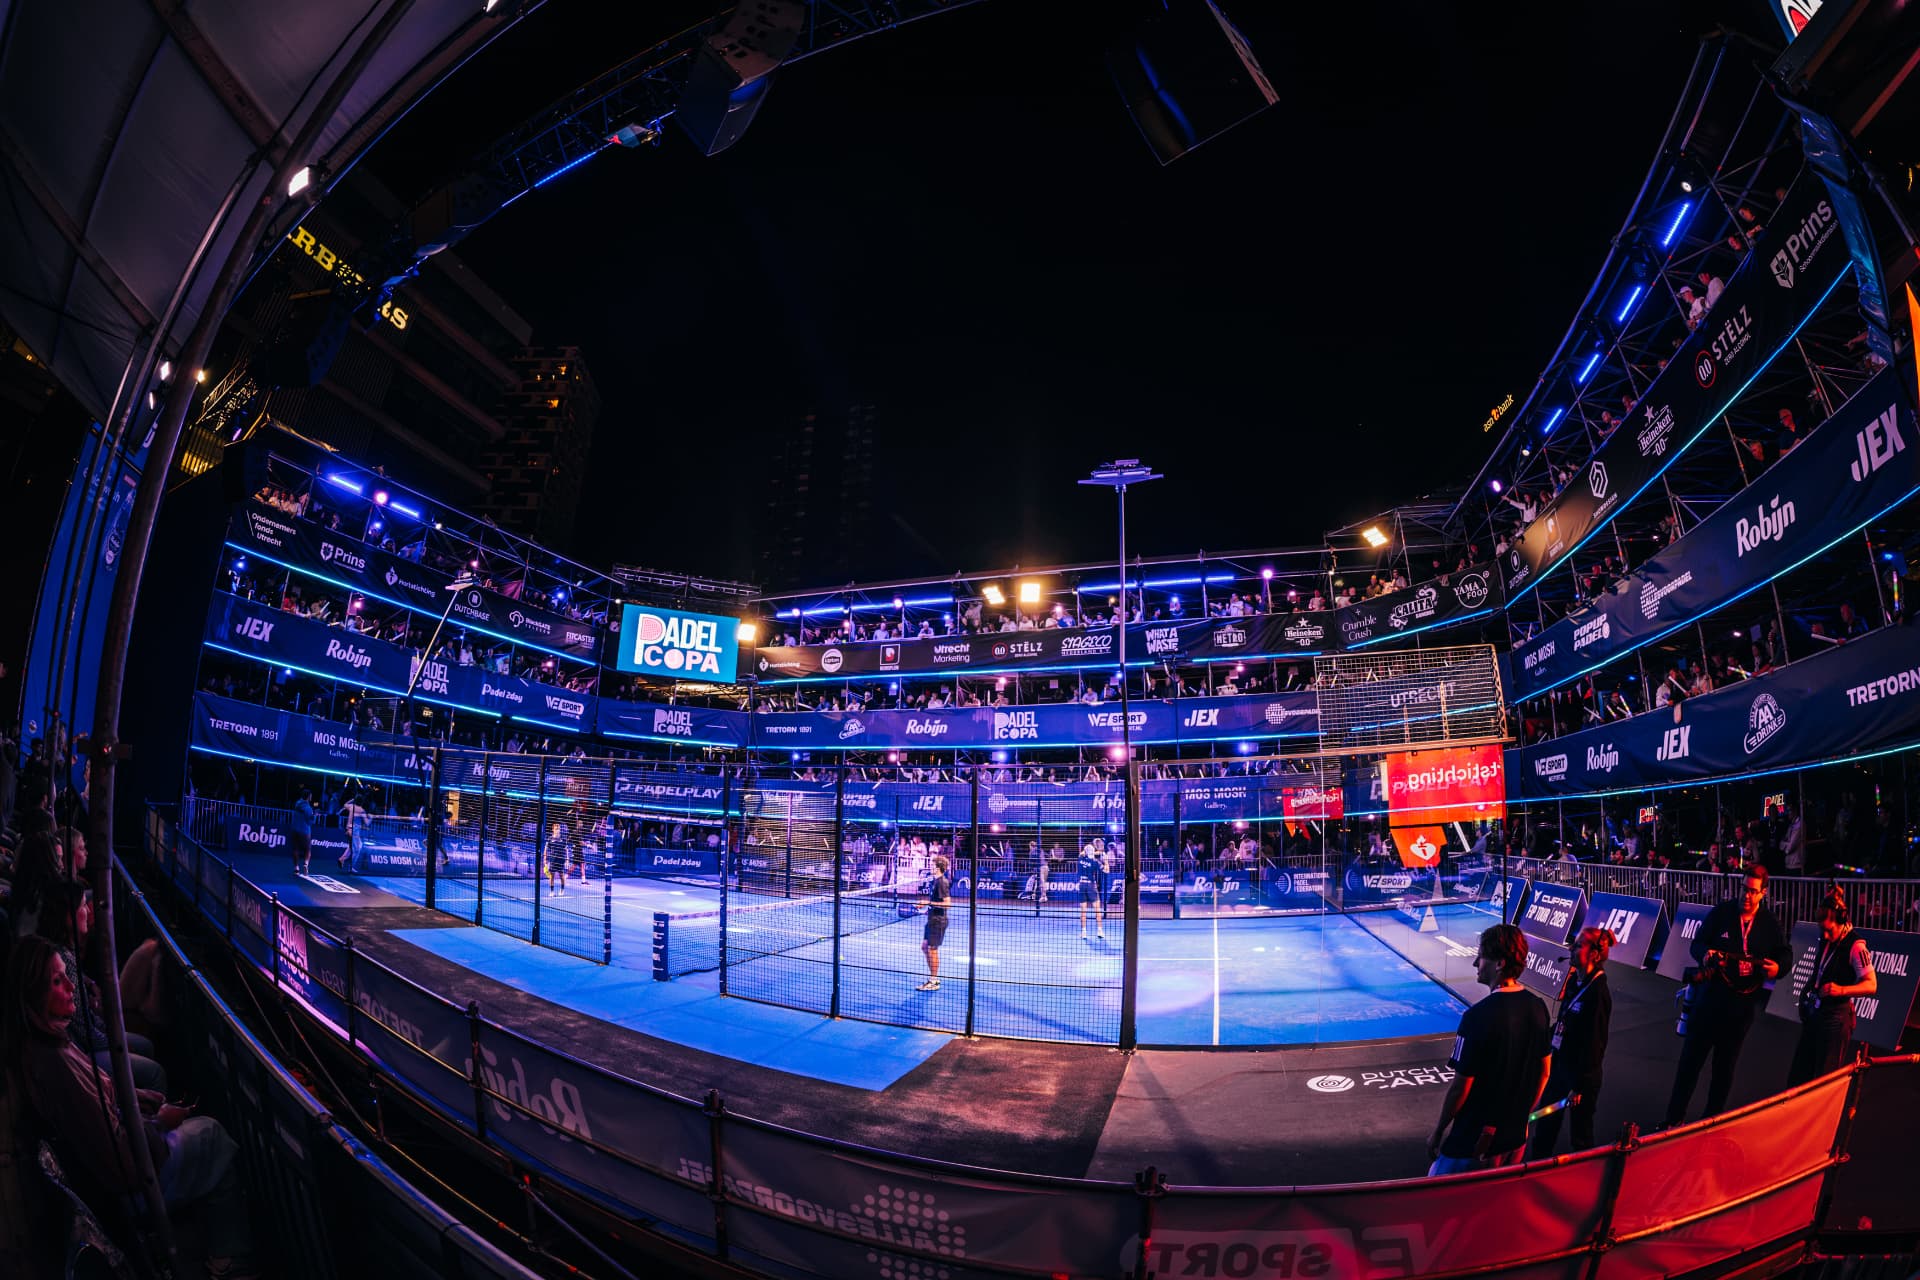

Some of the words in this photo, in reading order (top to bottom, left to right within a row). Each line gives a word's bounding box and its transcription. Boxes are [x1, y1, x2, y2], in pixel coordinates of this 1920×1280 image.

[1788, 200, 1832, 264] Prins
[1711, 304, 1753, 361] STËLZ
[1497, 394, 1515, 415] bank
[1639, 413, 1673, 450] Heineken
[1851, 402, 1906, 482] JEX
[251, 513, 297, 535] Ondernemers
[254, 523, 274, 536] fonds
[1735, 493, 1796, 558] Robijn
[256, 533, 282, 547] Utrecht
[333, 547, 367, 570] Prins
[1452, 583, 1480, 597] YAMA
[1467, 588, 1489, 601] FOOD
[236, 617, 275, 643] JEX
[1342, 614, 1378, 633] Crumble
[634, 613, 723, 665] PADEL
[1060, 634, 1112, 649] STAGECO
[1145, 628, 1168, 642] WHAT
[1168, 627, 1178, 639] A
[1288, 628, 1323, 639] Heineken
[1348, 627, 1373, 642] Crush
[1573, 628, 1602, 651] PADEL
[325, 640, 373, 668] Robijn
[1010, 641, 1043, 656] STËLZ
[1147, 637, 1179, 654] WASTE
[643, 645, 722, 674] COPA
[933, 654, 971, 666] Marketing
[482, 684, 504, 698] Padel
[504, 690, 523, 703] 2day
[1846, 666, 1920, 707] TRETORN
[561, 701, 582, 713] SPORT
[1757, 704, 1774, 729] AA
[654, 708, 693, 733] PADEL
[906, 718, 948, 735] Robijn
[994, 711, 1038, 739] PADEL
[1185, 708, 1219, 727] JEX
[209, 718, 258, 738] TRETORN
[261, 728, 280, 741] 1891
[314, 731, 336, 747] MOS
[657, 722, 693, 737] COPA
[998, 726, 1038, 739] COPA
[1755, 719, 1779, 744] DRINK
[1656, 724, 1692, 761] JEX
[1547, 757, 1565, 771] SPORT
[1586, 742, 1619, 773] Robijn
[634, 784, 722, 799] PADELPLAY
[913, 795, 944, 811] JEX
[238, 823, 287, 848] Robijn
[389, 856, 411, 867] MOSH
[653, 854, 680, 867] Padel
[680, 857, 702, 868] 2day
[1381, 877, 1406, 886] SPORT
[1550, 910, 1569, 928] 2026
[1598, 908, 1641, 945] JEX
[1360, 1066, 1441, 1080] DUTCH
